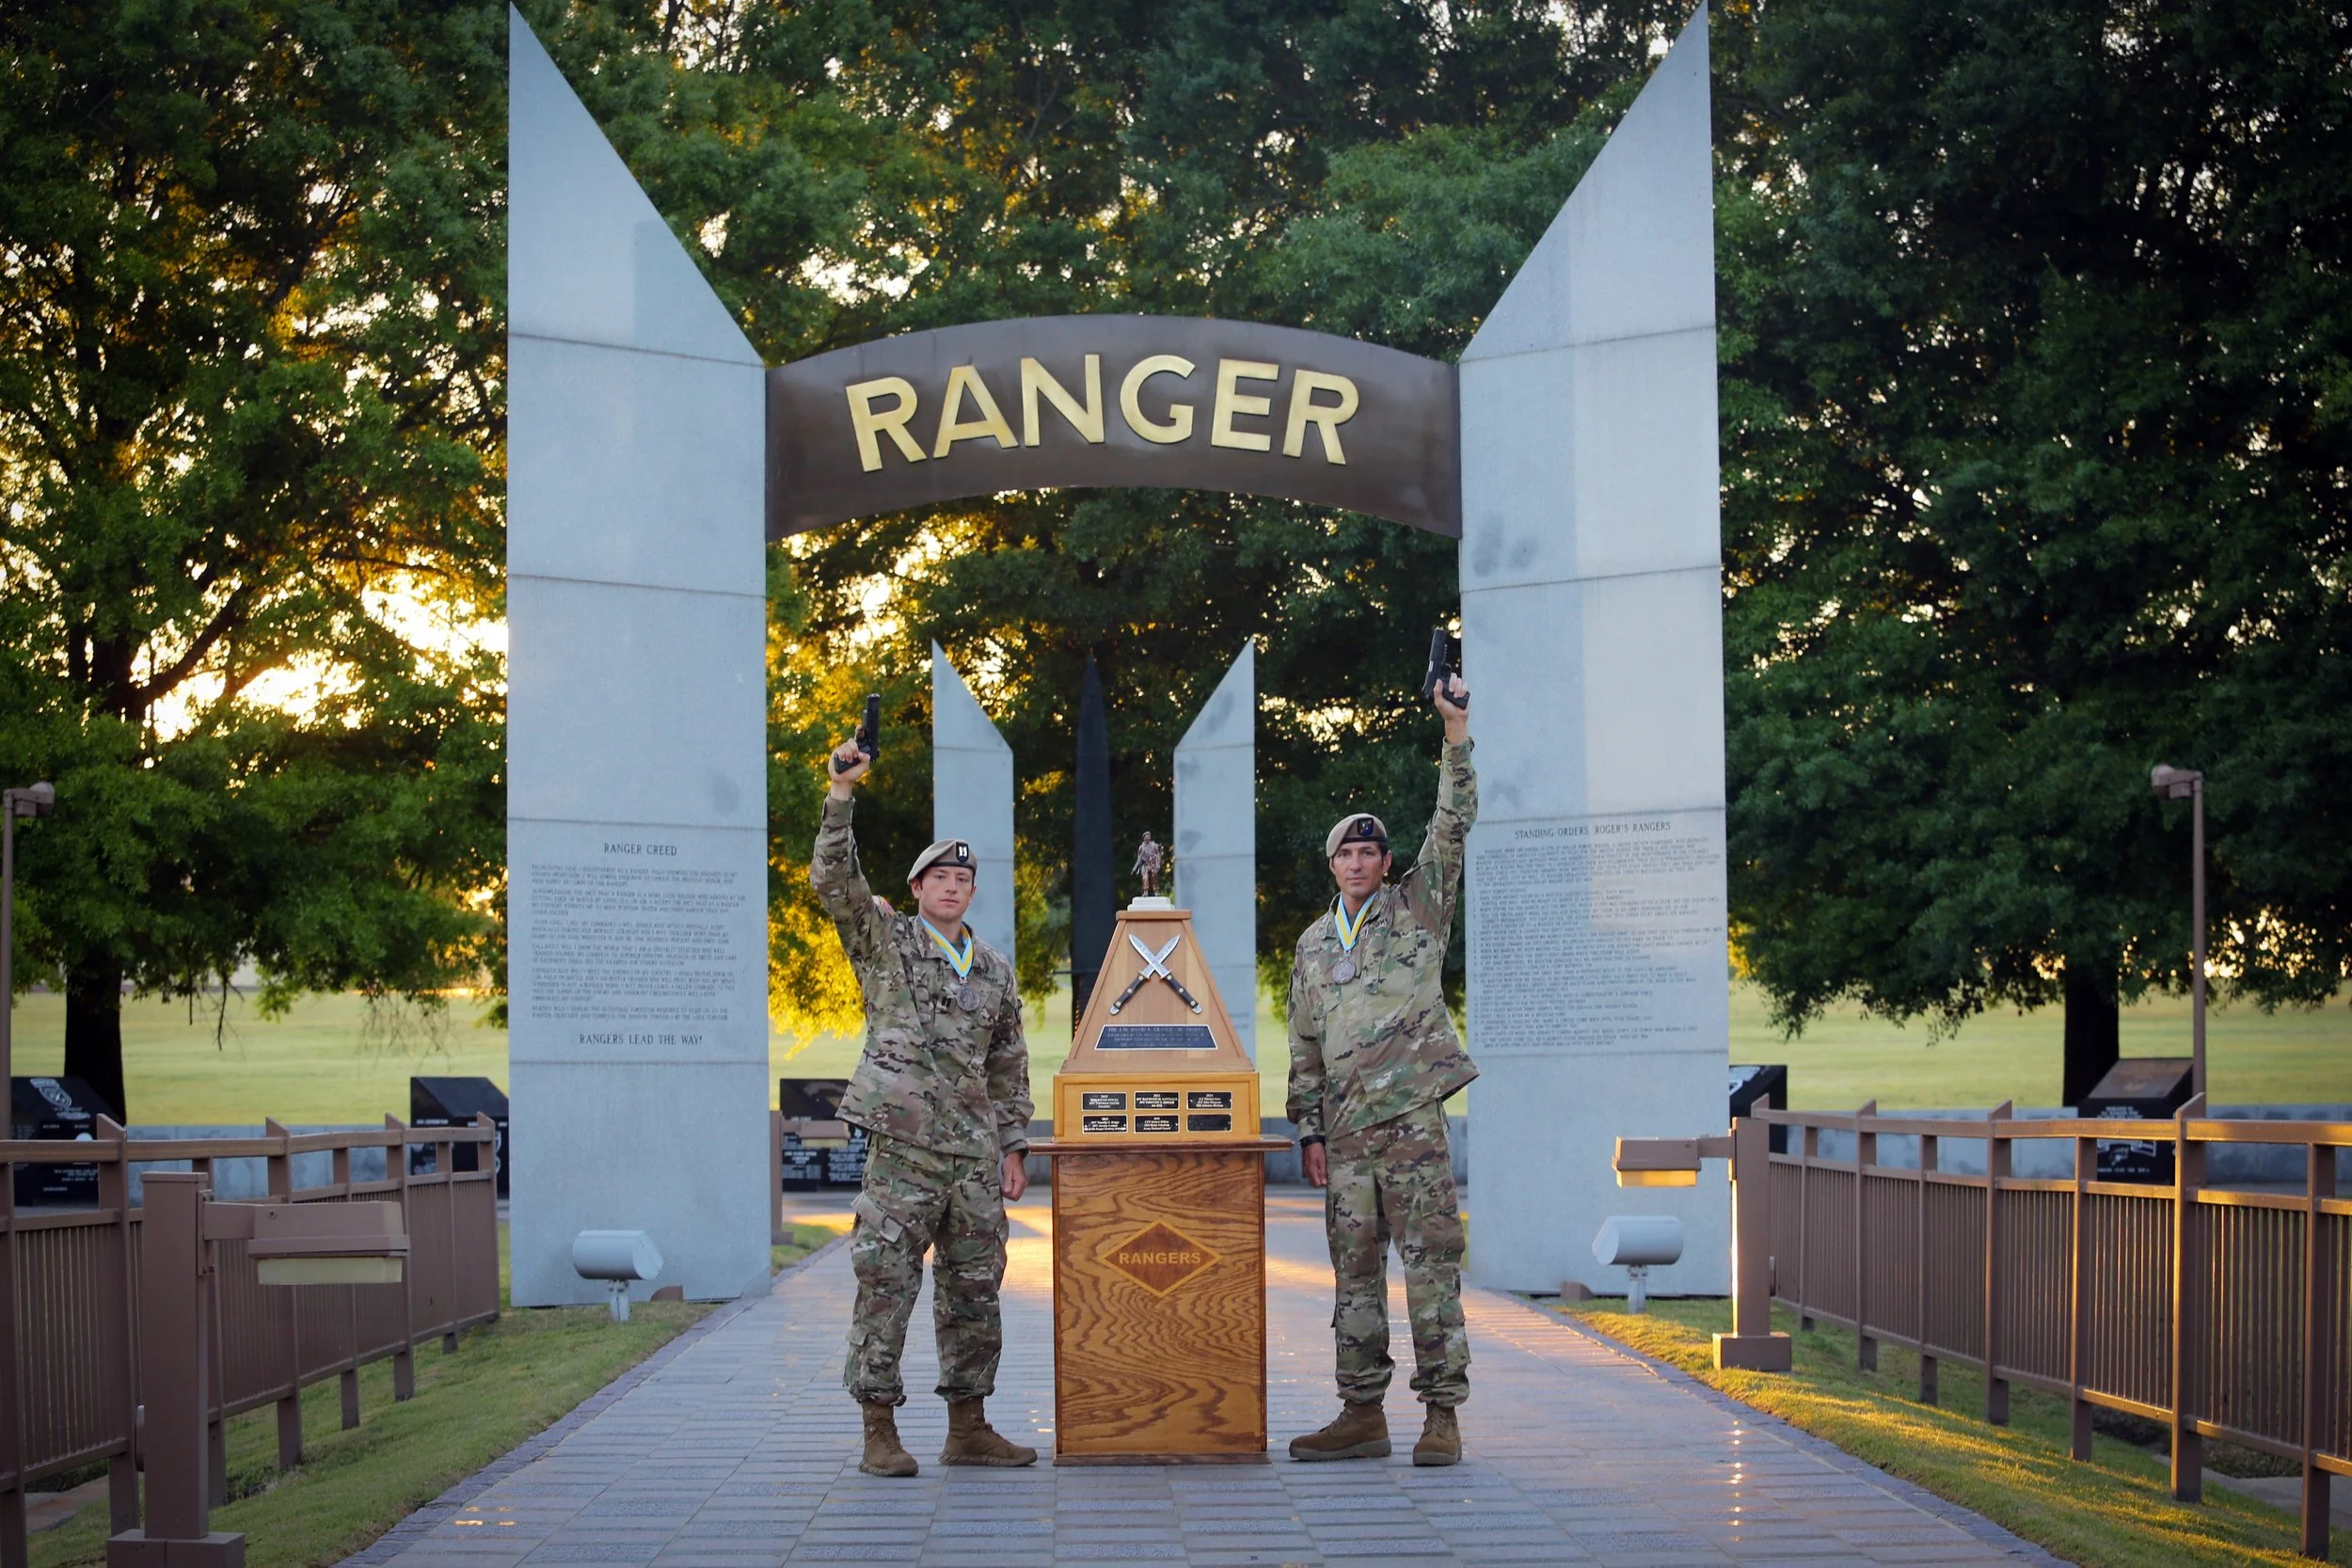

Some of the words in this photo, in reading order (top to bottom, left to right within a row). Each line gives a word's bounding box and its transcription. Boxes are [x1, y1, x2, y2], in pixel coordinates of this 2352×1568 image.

[846, 354, 1359, 472] RANGER
[1515, 828, 1554, 840] STANDING
[1557, 825, 1589, 837] ORDERS
[1595, 823, 1629, 835] ROGER'S
[1632, 821, 1671, 832] RANGERS
[604, 842, 642, 855] RANGER
[646, 844, 677, 856] CREED
[580, 1033, 624, 1045] RANGERS
[628, 1034, 654, 1046] LEAD
[658, 1034, 676, 1046] THE
[681, 1035, 703, 1046] WAY!
[1119, 1252, 1201, 1264] RANGERS
